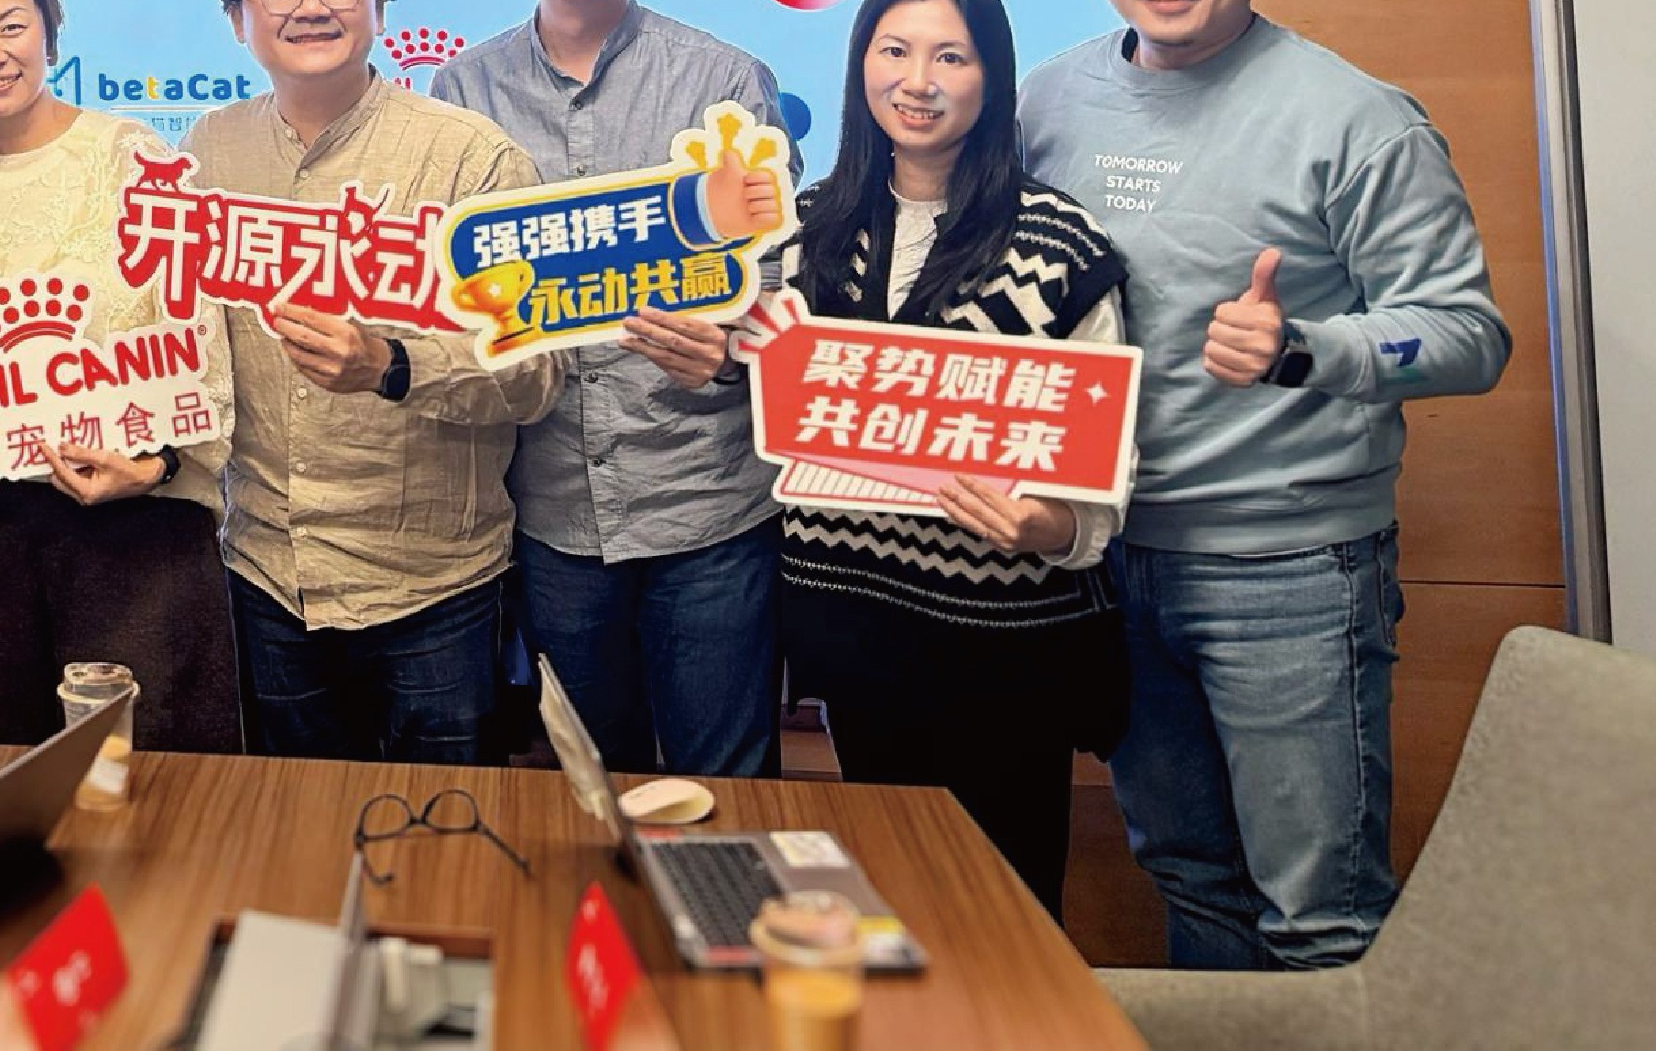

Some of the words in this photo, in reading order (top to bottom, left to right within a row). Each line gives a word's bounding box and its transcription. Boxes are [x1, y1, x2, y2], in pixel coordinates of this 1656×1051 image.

[98, 73, 251, 101] betaCat
[1095, 154, 1184, 175] TOMORROW
[1106, 175, 1161, 193] STARTS
[471, 195, 667, 268] 强强携手
[1105, 195, 1156, 213] TODAY
[125, 190, 439, 306] 开源永动
[527, 255, 730, 323] 永动共赢
[802, 339, 1077, 413] 聚势赋能
[794, 396, 1068, 472] 共创未来
